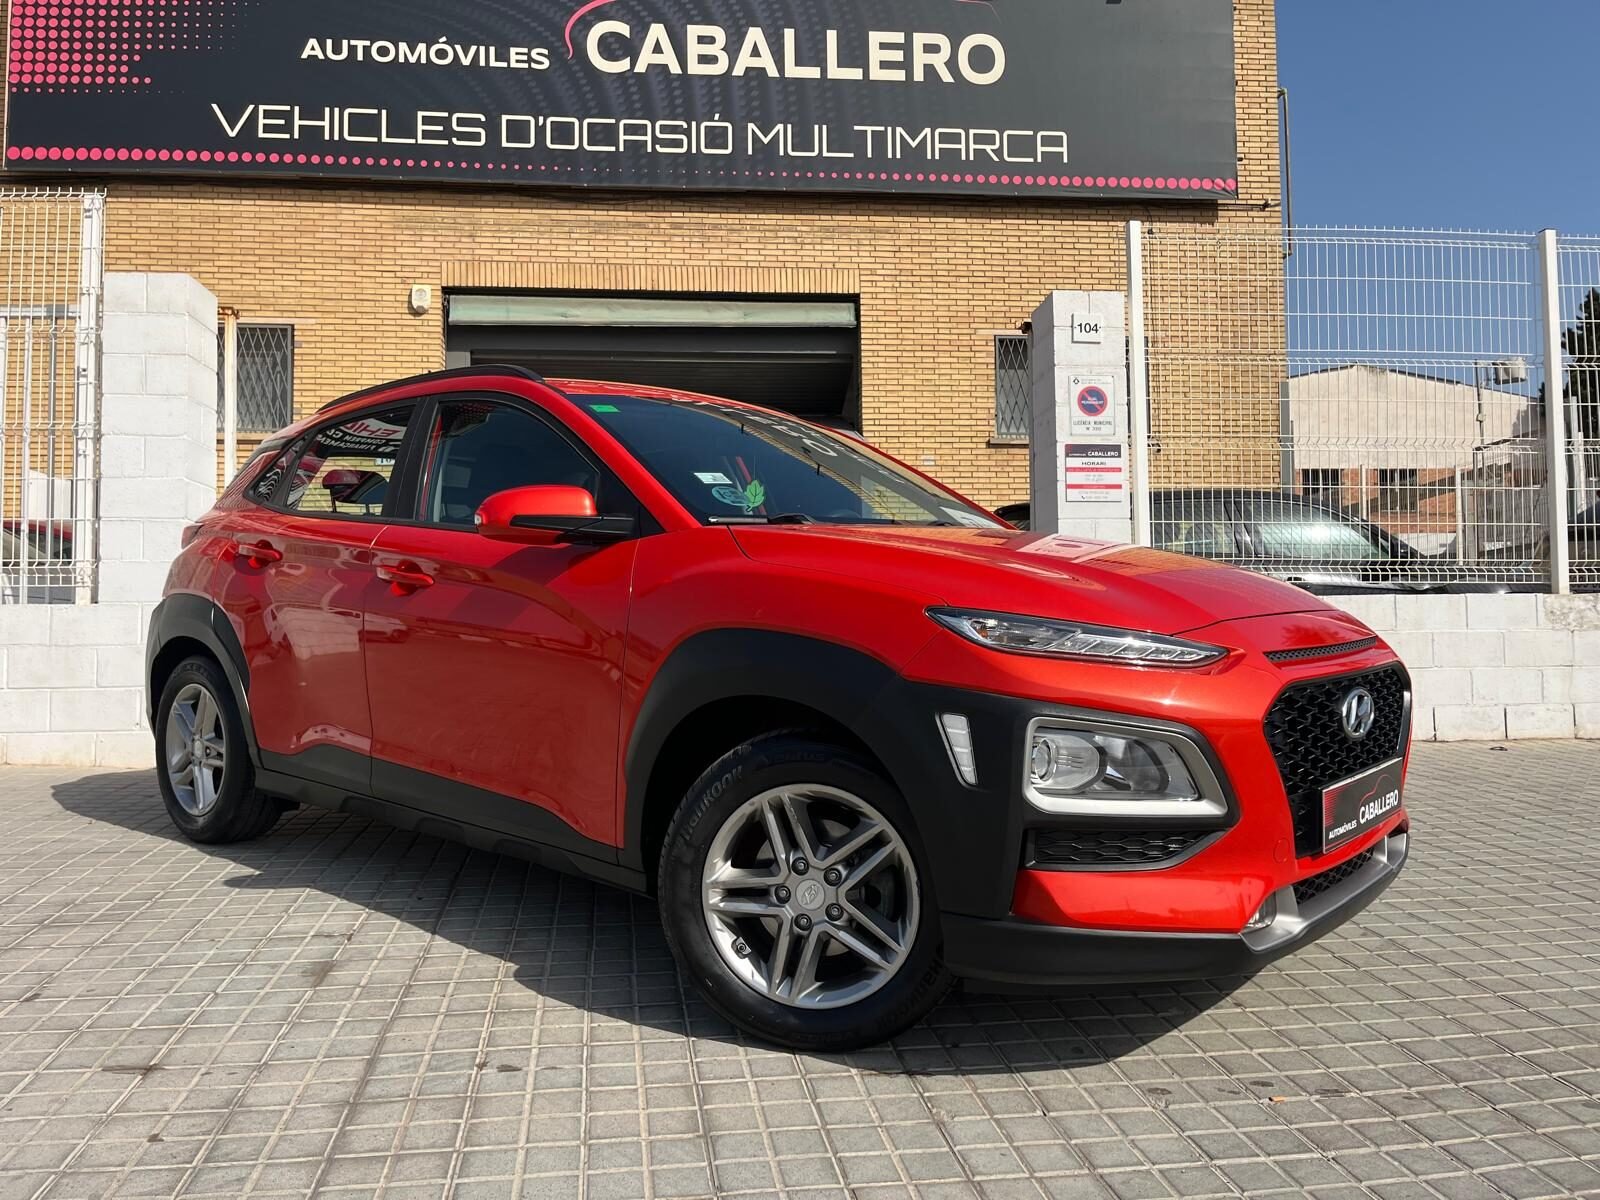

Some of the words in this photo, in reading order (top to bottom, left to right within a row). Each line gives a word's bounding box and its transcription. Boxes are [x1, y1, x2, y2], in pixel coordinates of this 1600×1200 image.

[301, 36, 550, 70] AUTOMÓVILES
[586, 21, 1006, 84] CABALLERO
[211, 103, 486, 147] VEHICLES
[501, 113, 733, 155] D'OCASIÓ
[748, 123, 1068, 164] MULTIMARCA
[1077, 322, 1099, 334] 104
[1328, 820, 1357, 839] AUTOMÓVILES
[1359, 789, 1399, 824] CABALLERO
